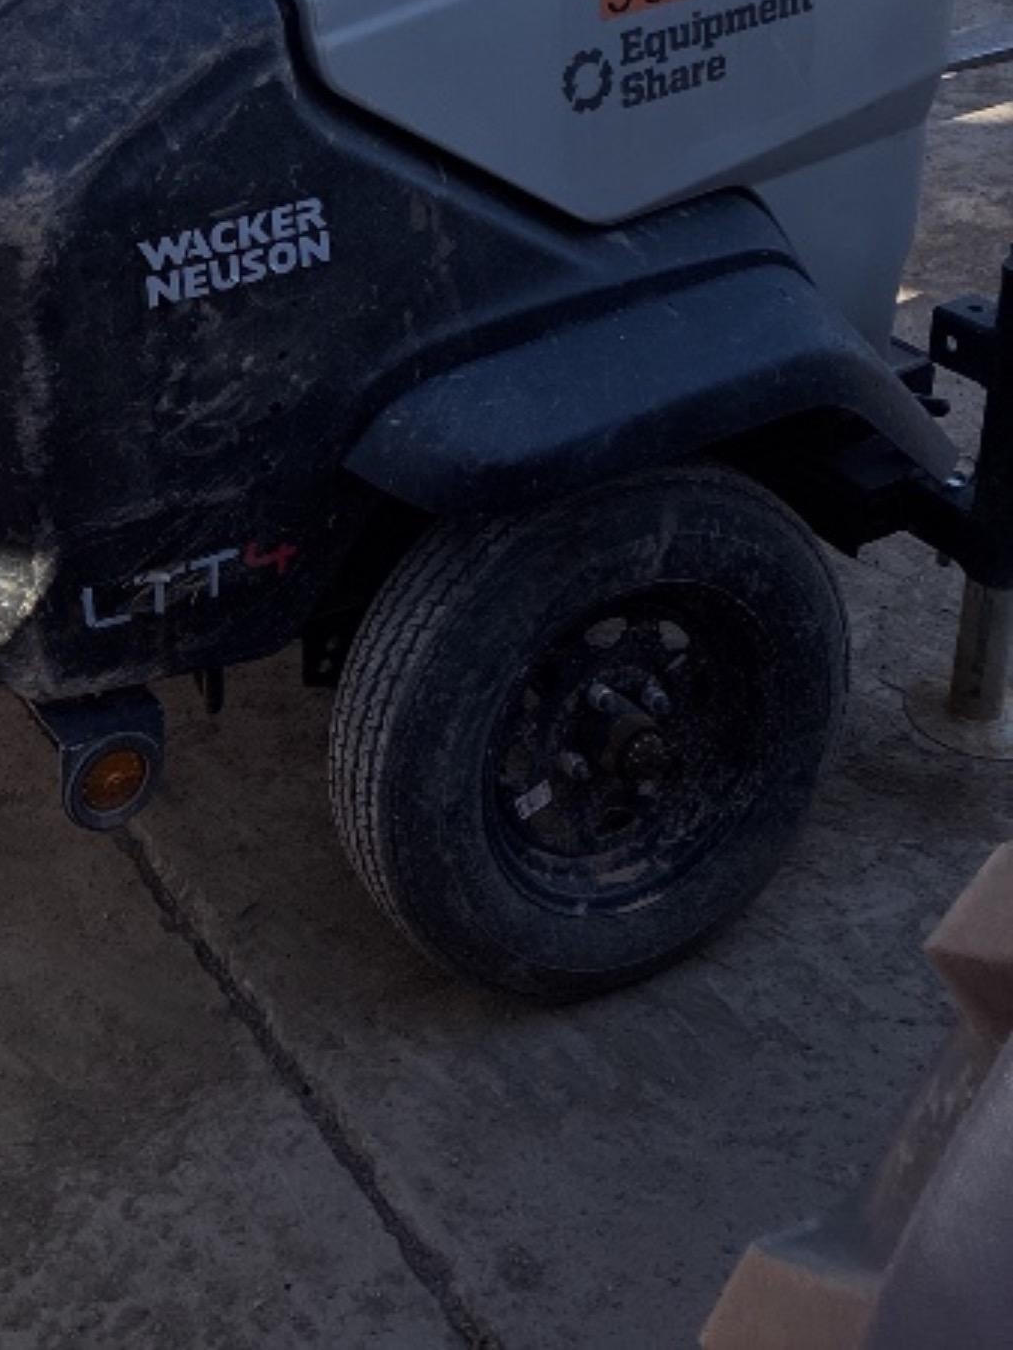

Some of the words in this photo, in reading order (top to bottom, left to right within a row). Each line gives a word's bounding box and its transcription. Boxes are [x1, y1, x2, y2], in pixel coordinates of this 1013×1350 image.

[620, 54, 727, 109] Share
[137, 197, 327, 271] WACKER
[145, 231, 331, 310] NEUSON
